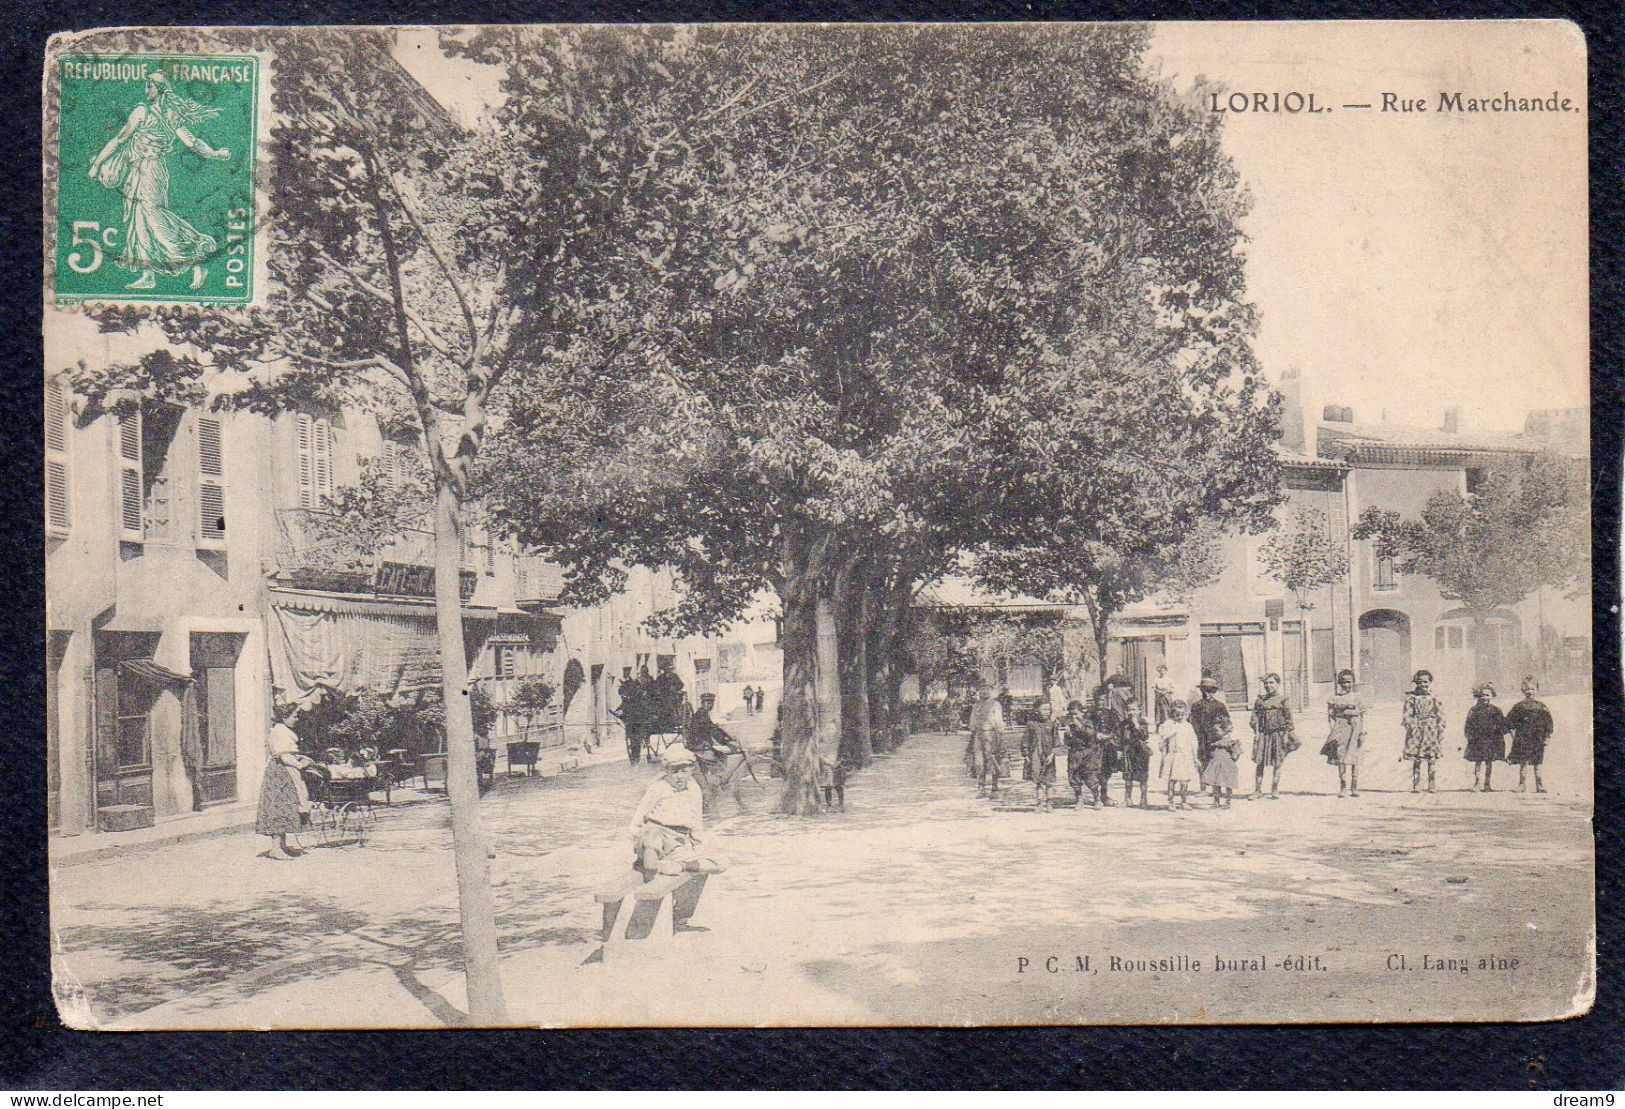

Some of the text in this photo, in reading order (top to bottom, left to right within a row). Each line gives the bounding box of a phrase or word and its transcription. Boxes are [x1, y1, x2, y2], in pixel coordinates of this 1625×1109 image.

[64, 62, 250, 84] REPUBLIQUE FRANÇAISE
[1210, 91, 1333, 113] LORIOL.
[1381, 92, 1427, 113] Rue
[1436, 91, 1580, 113] Marchande.
[224, 206, 247, 289] POSTES
[1017, 956, 1030, 973] P
[1109, 955, 1201, 972] Roussille
[1214, 954, 1267, 972] bural
[1386, 953, 1413, 972] Cl.
